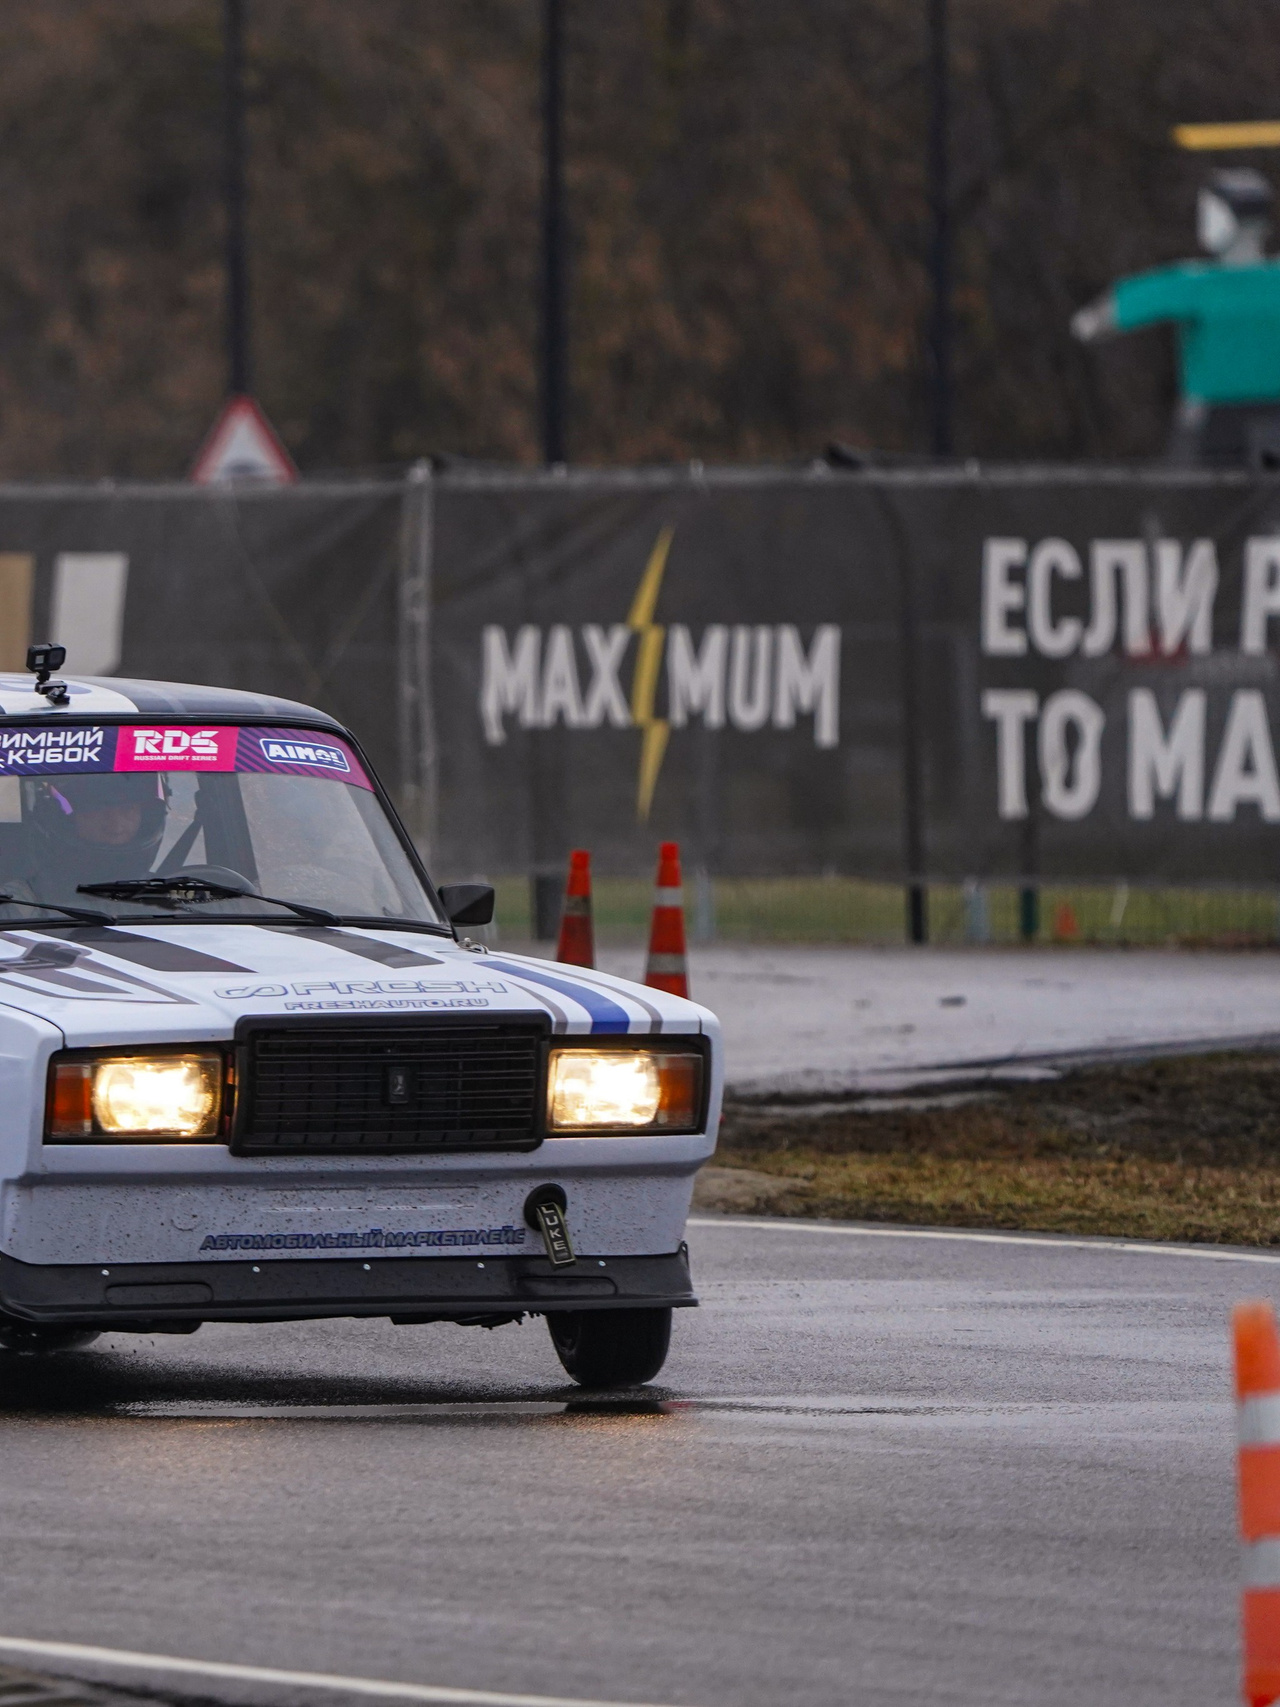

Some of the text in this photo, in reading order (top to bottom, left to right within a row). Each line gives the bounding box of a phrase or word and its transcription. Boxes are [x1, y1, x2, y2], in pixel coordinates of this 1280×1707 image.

[981, 537, 1218, 658] ЕСЛИ
[132, 730, 219, 754] RDS
[7, 747, 101, 765] КУБОК
[269, 744, 345, 766] AIMOL
[981, 688, 1106, 820] ТО
[284, 998, 489, 1011] FRESHAUTO.RU
[200, 1229, 383, 1250] АВТОМОБИЛЬНЫЙ
[540, 1206, 568, 1251] LUKE
